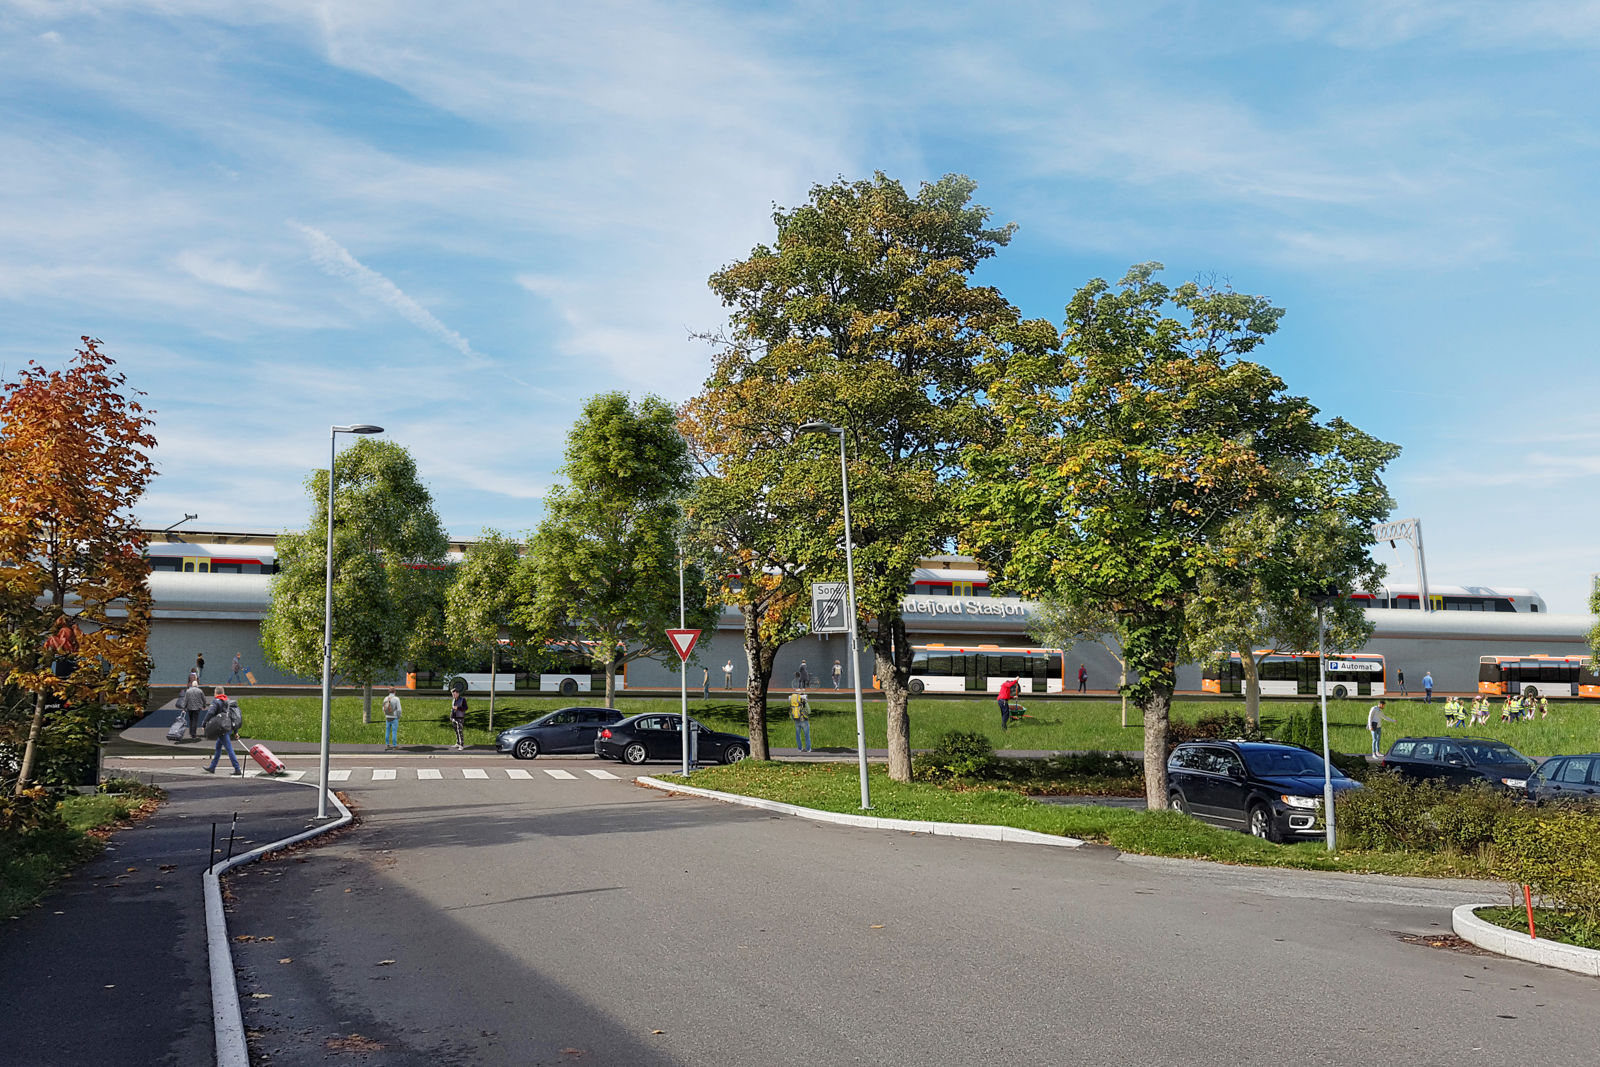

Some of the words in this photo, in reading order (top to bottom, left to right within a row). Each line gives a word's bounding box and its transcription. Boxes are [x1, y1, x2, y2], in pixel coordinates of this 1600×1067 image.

[817, 585, 840, 595] Son
[898, 599, 962, 616] ndefjord
[965, 600, 1024, 618] Stasjon
[1341, 662, 1373, 671] Automat
